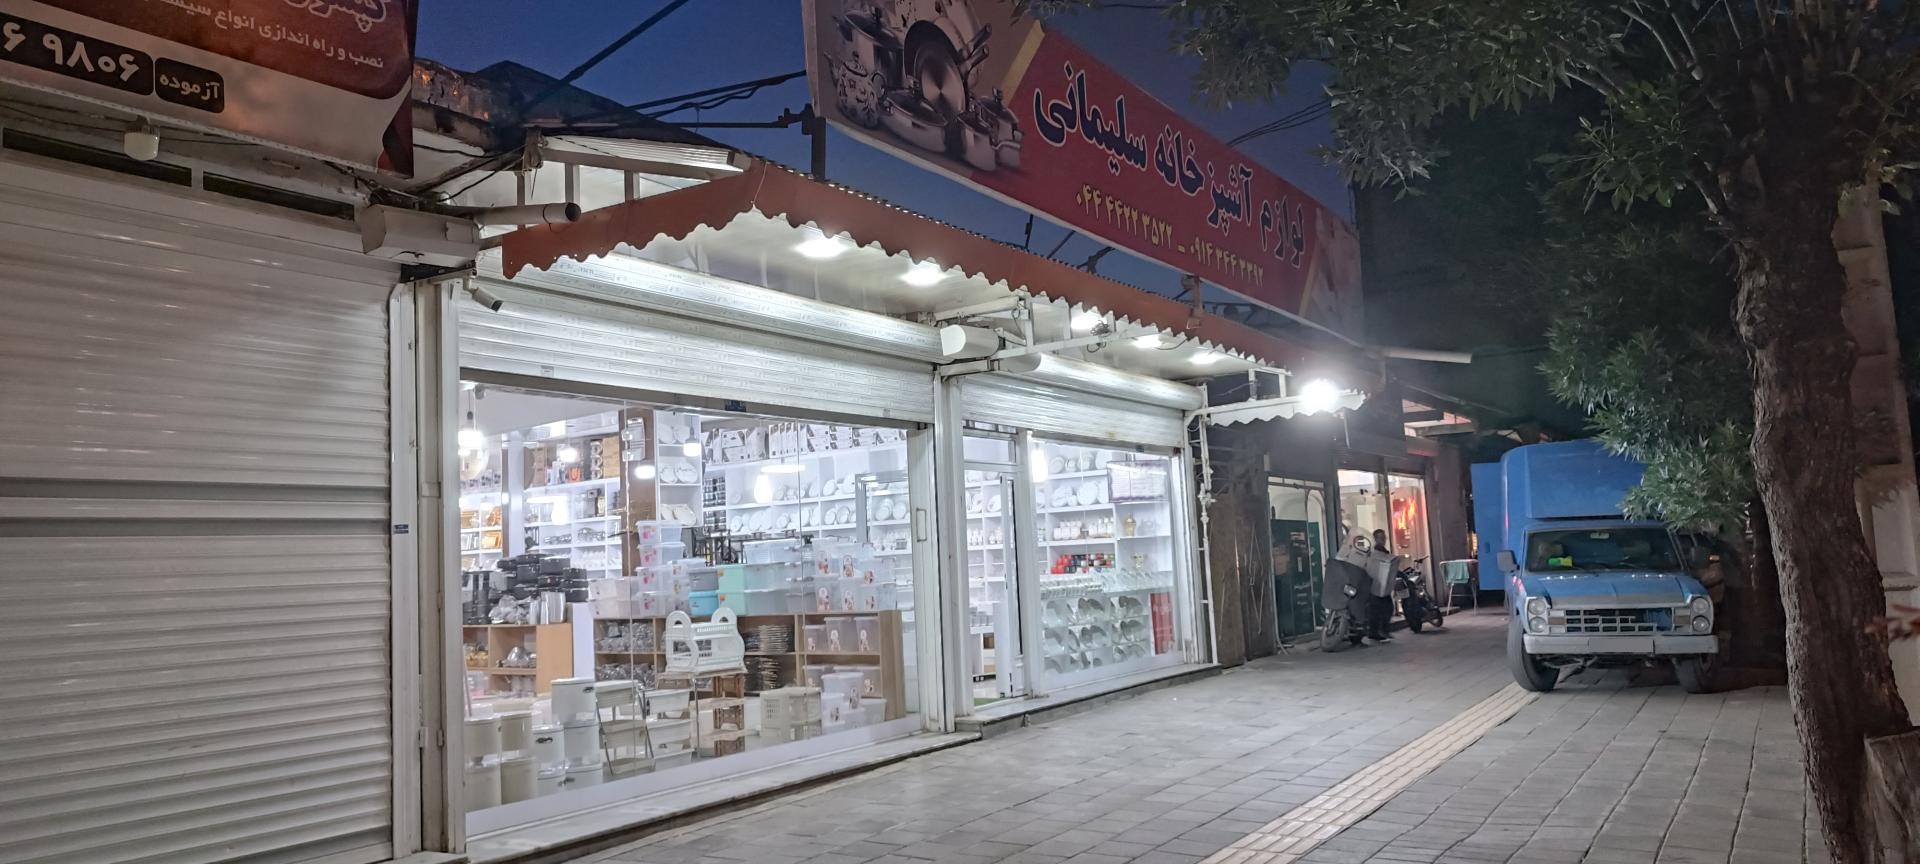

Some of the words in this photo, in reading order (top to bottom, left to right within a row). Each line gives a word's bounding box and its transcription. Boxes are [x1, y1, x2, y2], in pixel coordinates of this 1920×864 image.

[214, 10, 255, 30] انواع
[258, 25, 309, 47] اندازی
[313, 39, 335, 57] راه
[337, 48, 346, 61] و
[349, 53, 384, 69] نصب
[159, 73, 221, 101] آزموده
[1033, 60, 1148, 176] سلیمانی
[1076, 184, 1102, 220] ۰۴۴
[1105, 194, 1139, 237] ۴۴۲۲
[1259, 194, 1305, 269] لوازم
